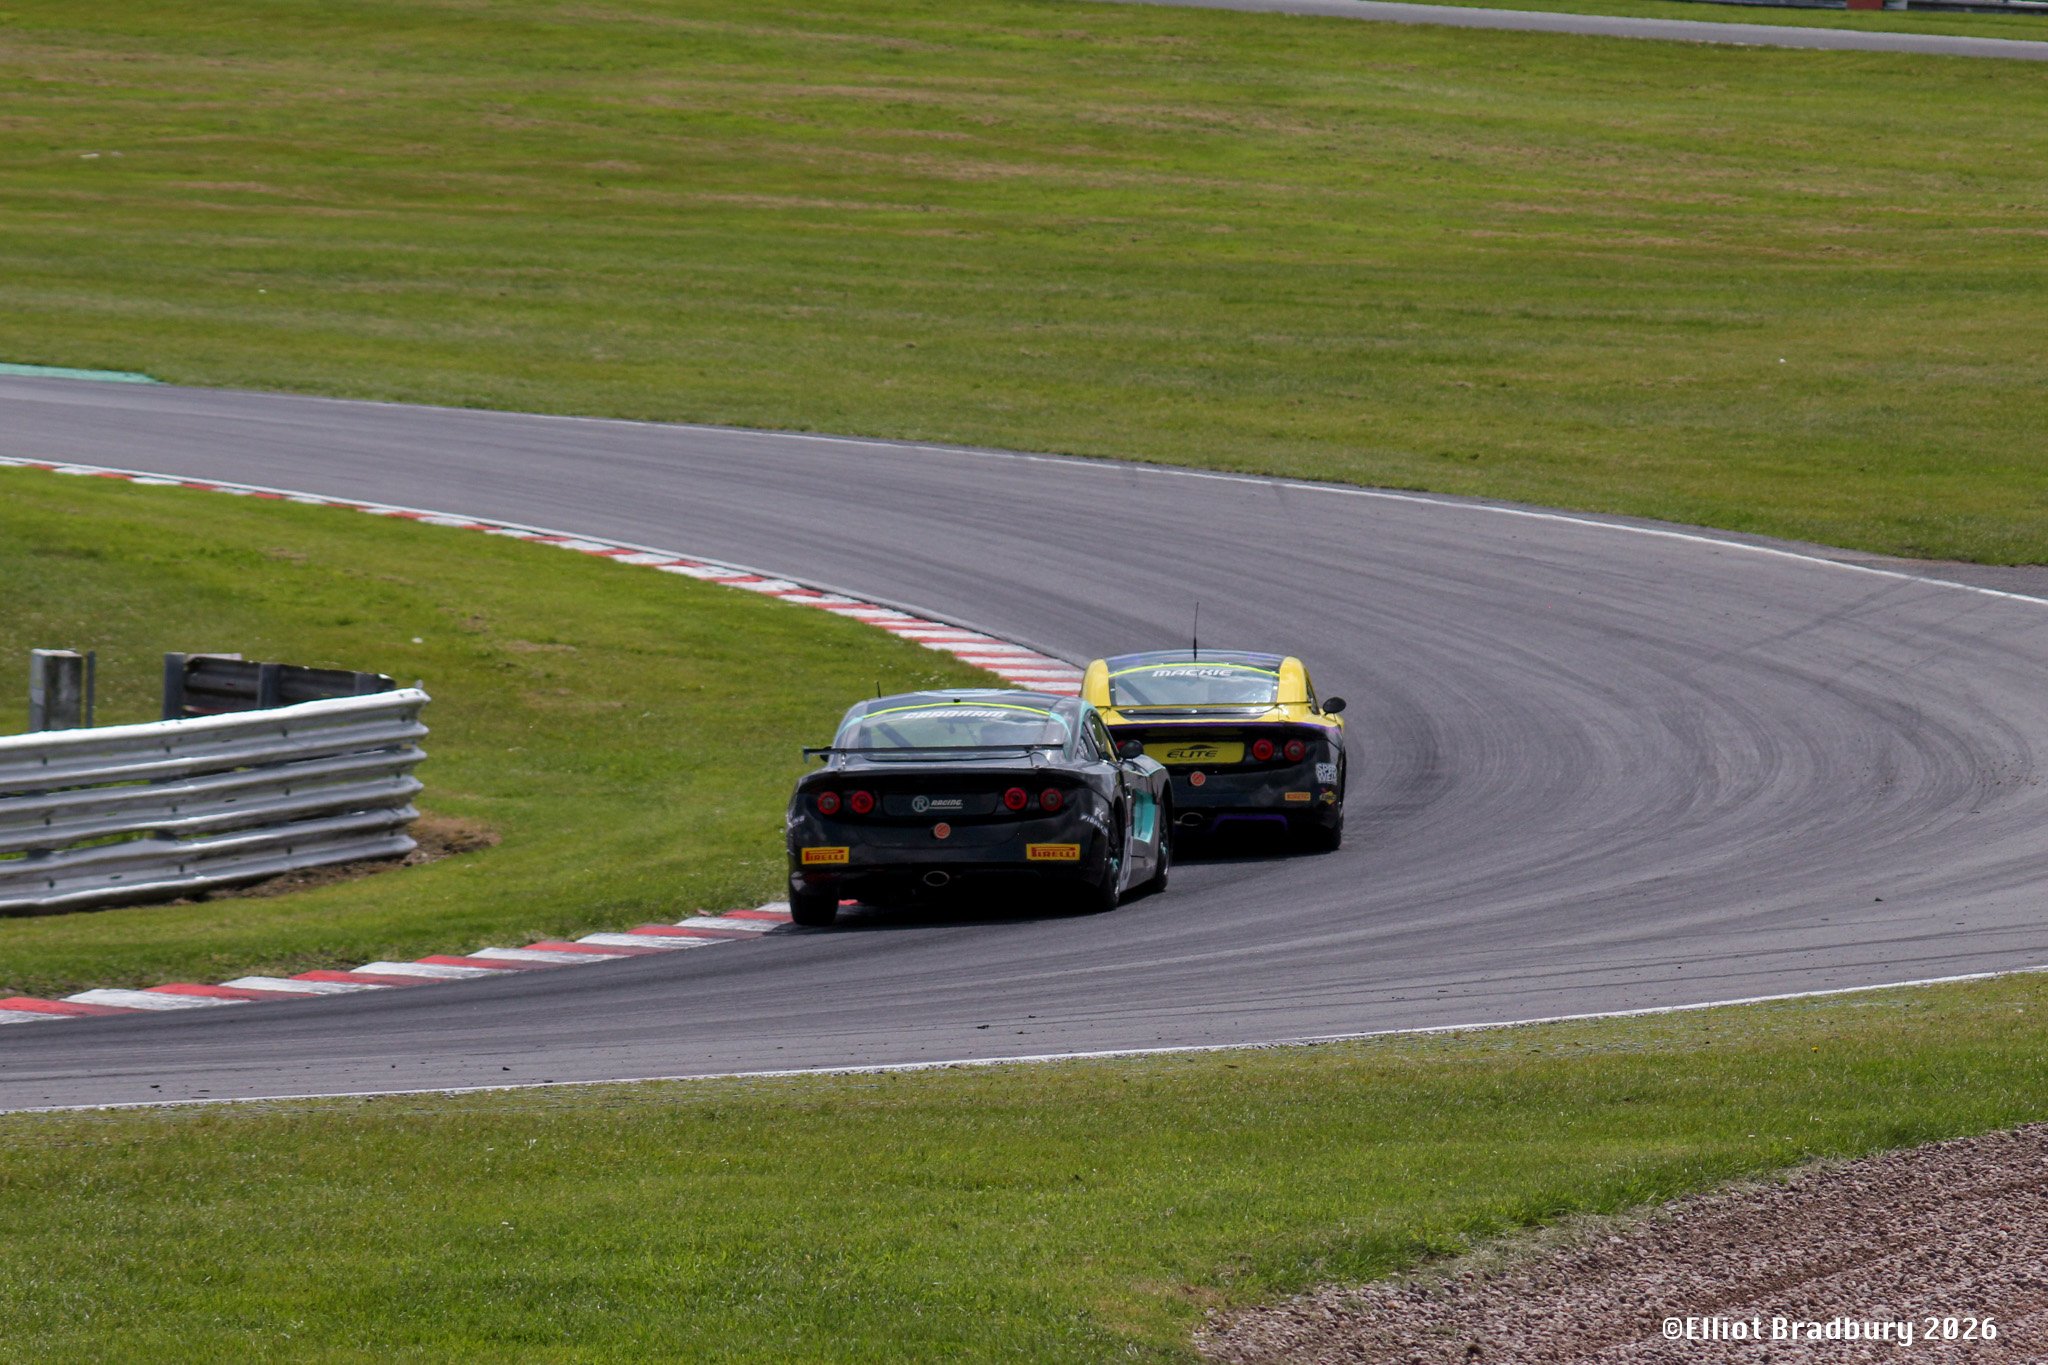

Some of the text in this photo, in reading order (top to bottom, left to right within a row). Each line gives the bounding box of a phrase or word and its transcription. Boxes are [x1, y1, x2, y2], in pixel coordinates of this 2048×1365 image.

[1152, 669, 1233, 677] MACKIE
[1167, 750, 1218, 759] ELITE
[805, 849, 845, 862] PIRELLI
[1030, 846, 1077, 858] PIRELLI
